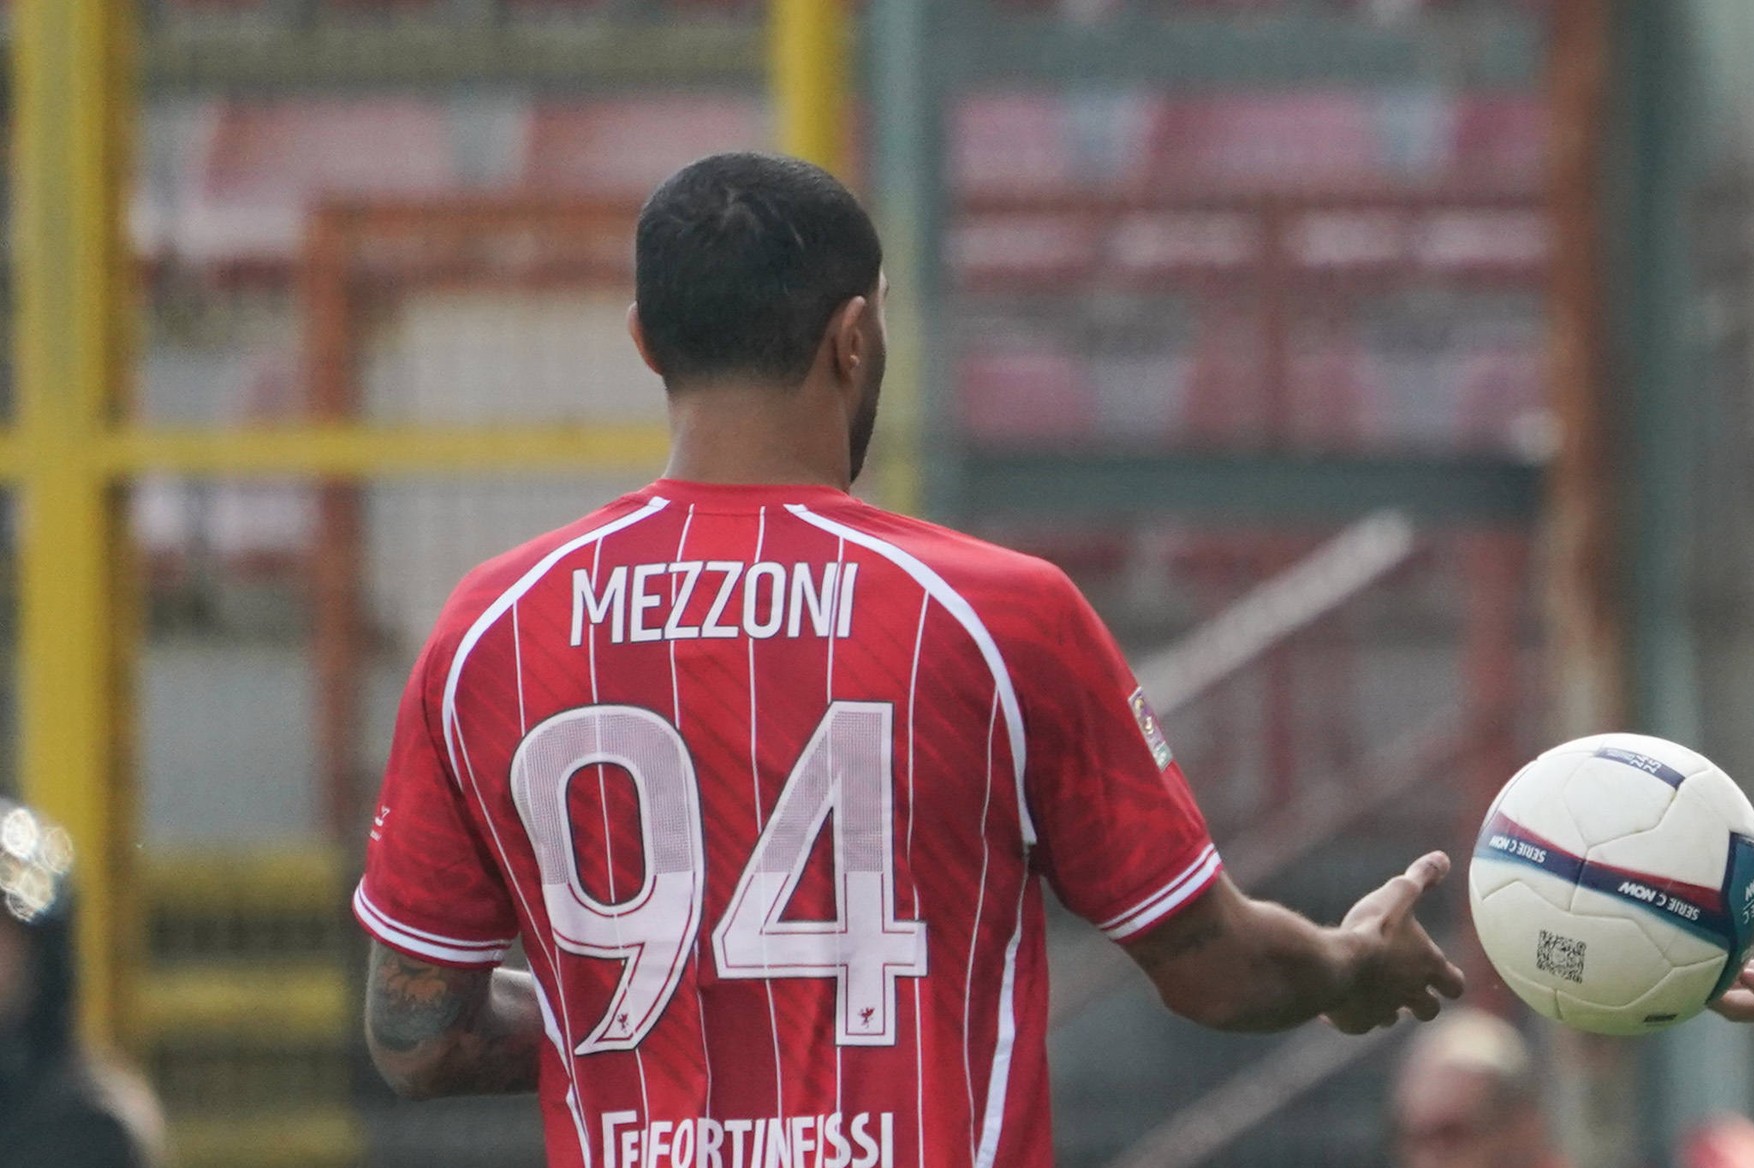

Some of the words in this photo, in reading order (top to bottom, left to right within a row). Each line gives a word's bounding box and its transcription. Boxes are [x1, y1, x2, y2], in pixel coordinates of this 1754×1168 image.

[570, 560, 859, 647] MEZZONI
[1488, 835, 1510, 850] NOW
[1516, 841, 1547, 864] SERIE
[509, 699, 929, 1056] 94
[1617, 881, 1657, 903] NOW
[1655, 893, 1668, 907] C
[1667, 898, 1701, 921] SERIE
